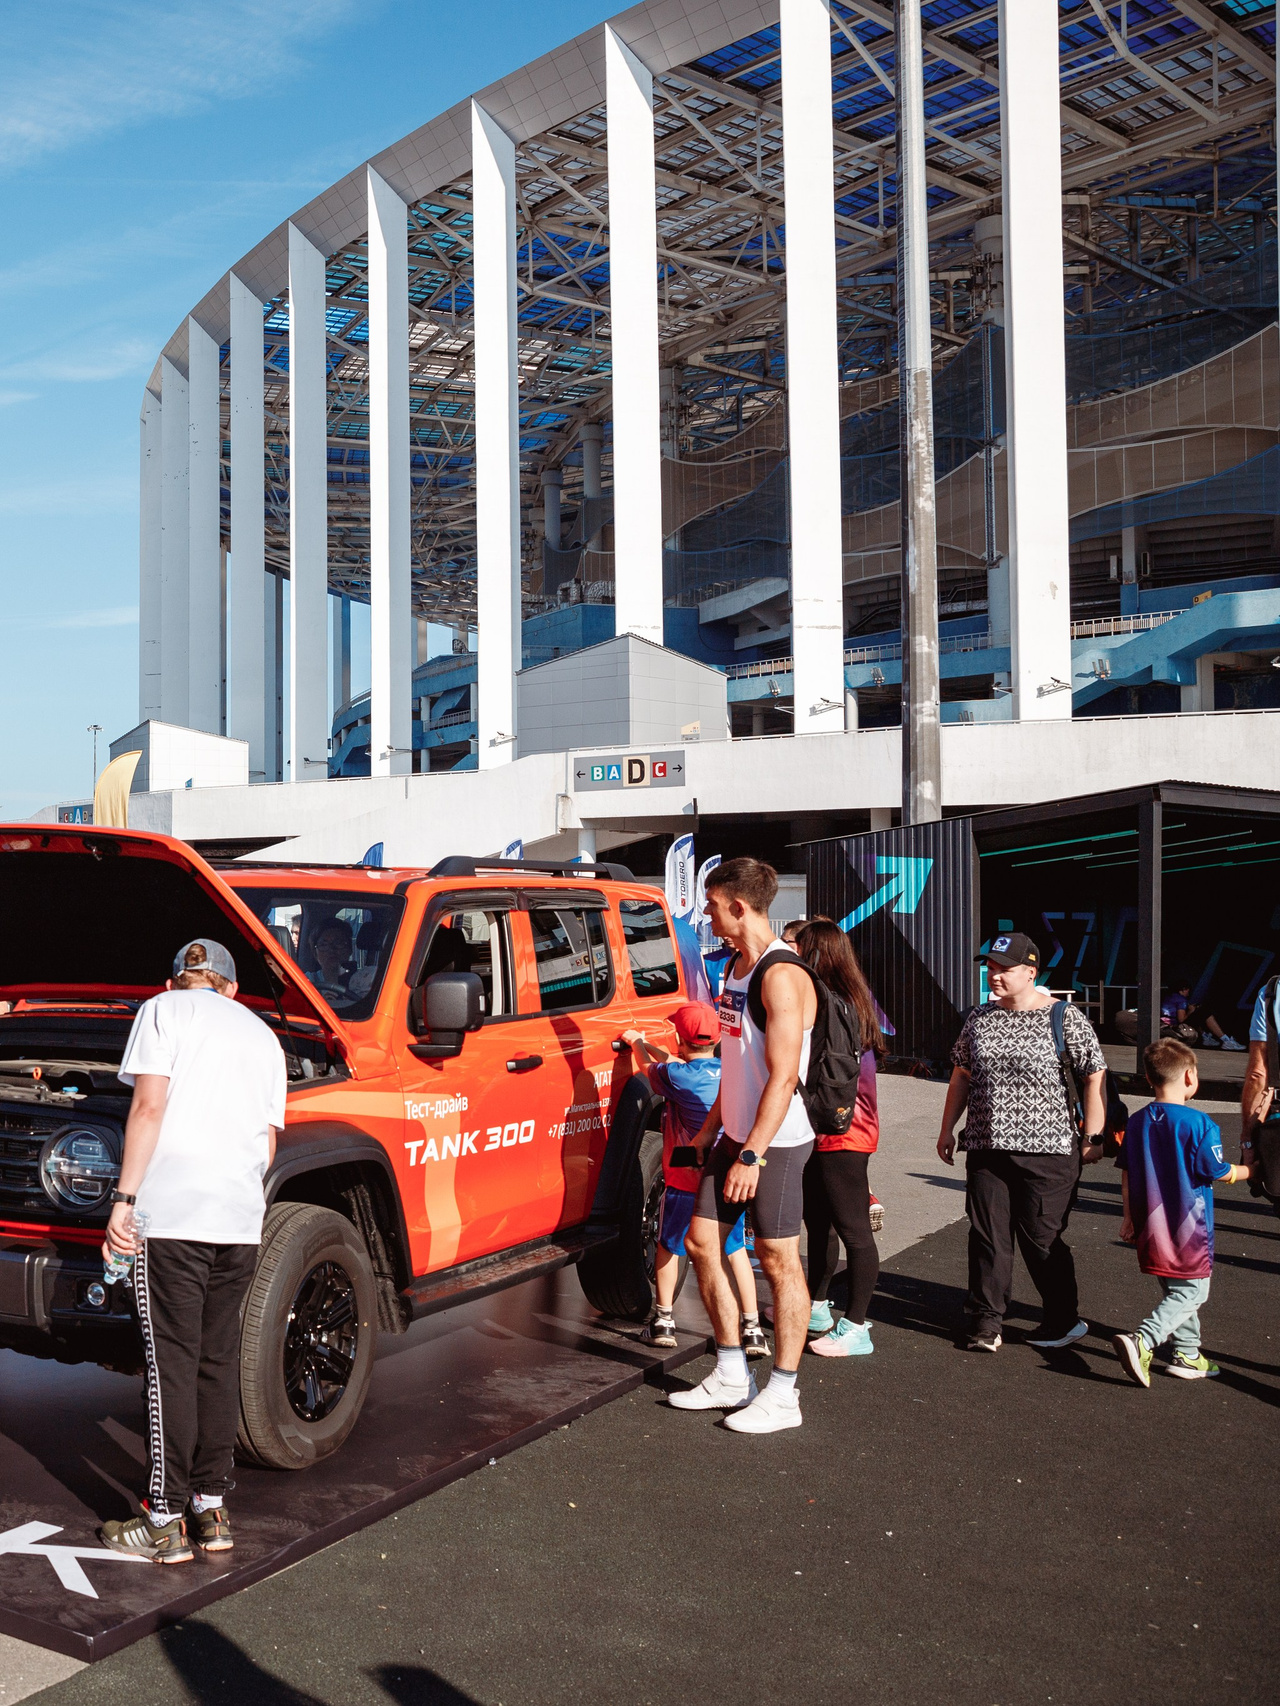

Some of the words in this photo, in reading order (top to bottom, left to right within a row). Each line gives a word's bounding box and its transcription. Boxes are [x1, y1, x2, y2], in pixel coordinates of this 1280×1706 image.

[593, 767, 603, 780] B
[608, 766, 620, 780] A
[627, 758, 645, 784] D
[655, 763, 664, 777] C
[678, 861, 686, 897] TORERO
[720, 1010, 736, 1023] 2338
[593, 1070, 613, 1088] АГАТ
[405, 1093, 468, 1120] Тест-драйв
[548, 1124, 558, 1139] +7
[557, 1120, 576, 1139] (831)
[576, 1117, 592, 1133] 200
[592, 1115, 602, 1130] 02
[602, 1114, 612, 1128] 02
[404, 1129, 480, 1167] TANK
[483, 1119, 535, 1151] 300
